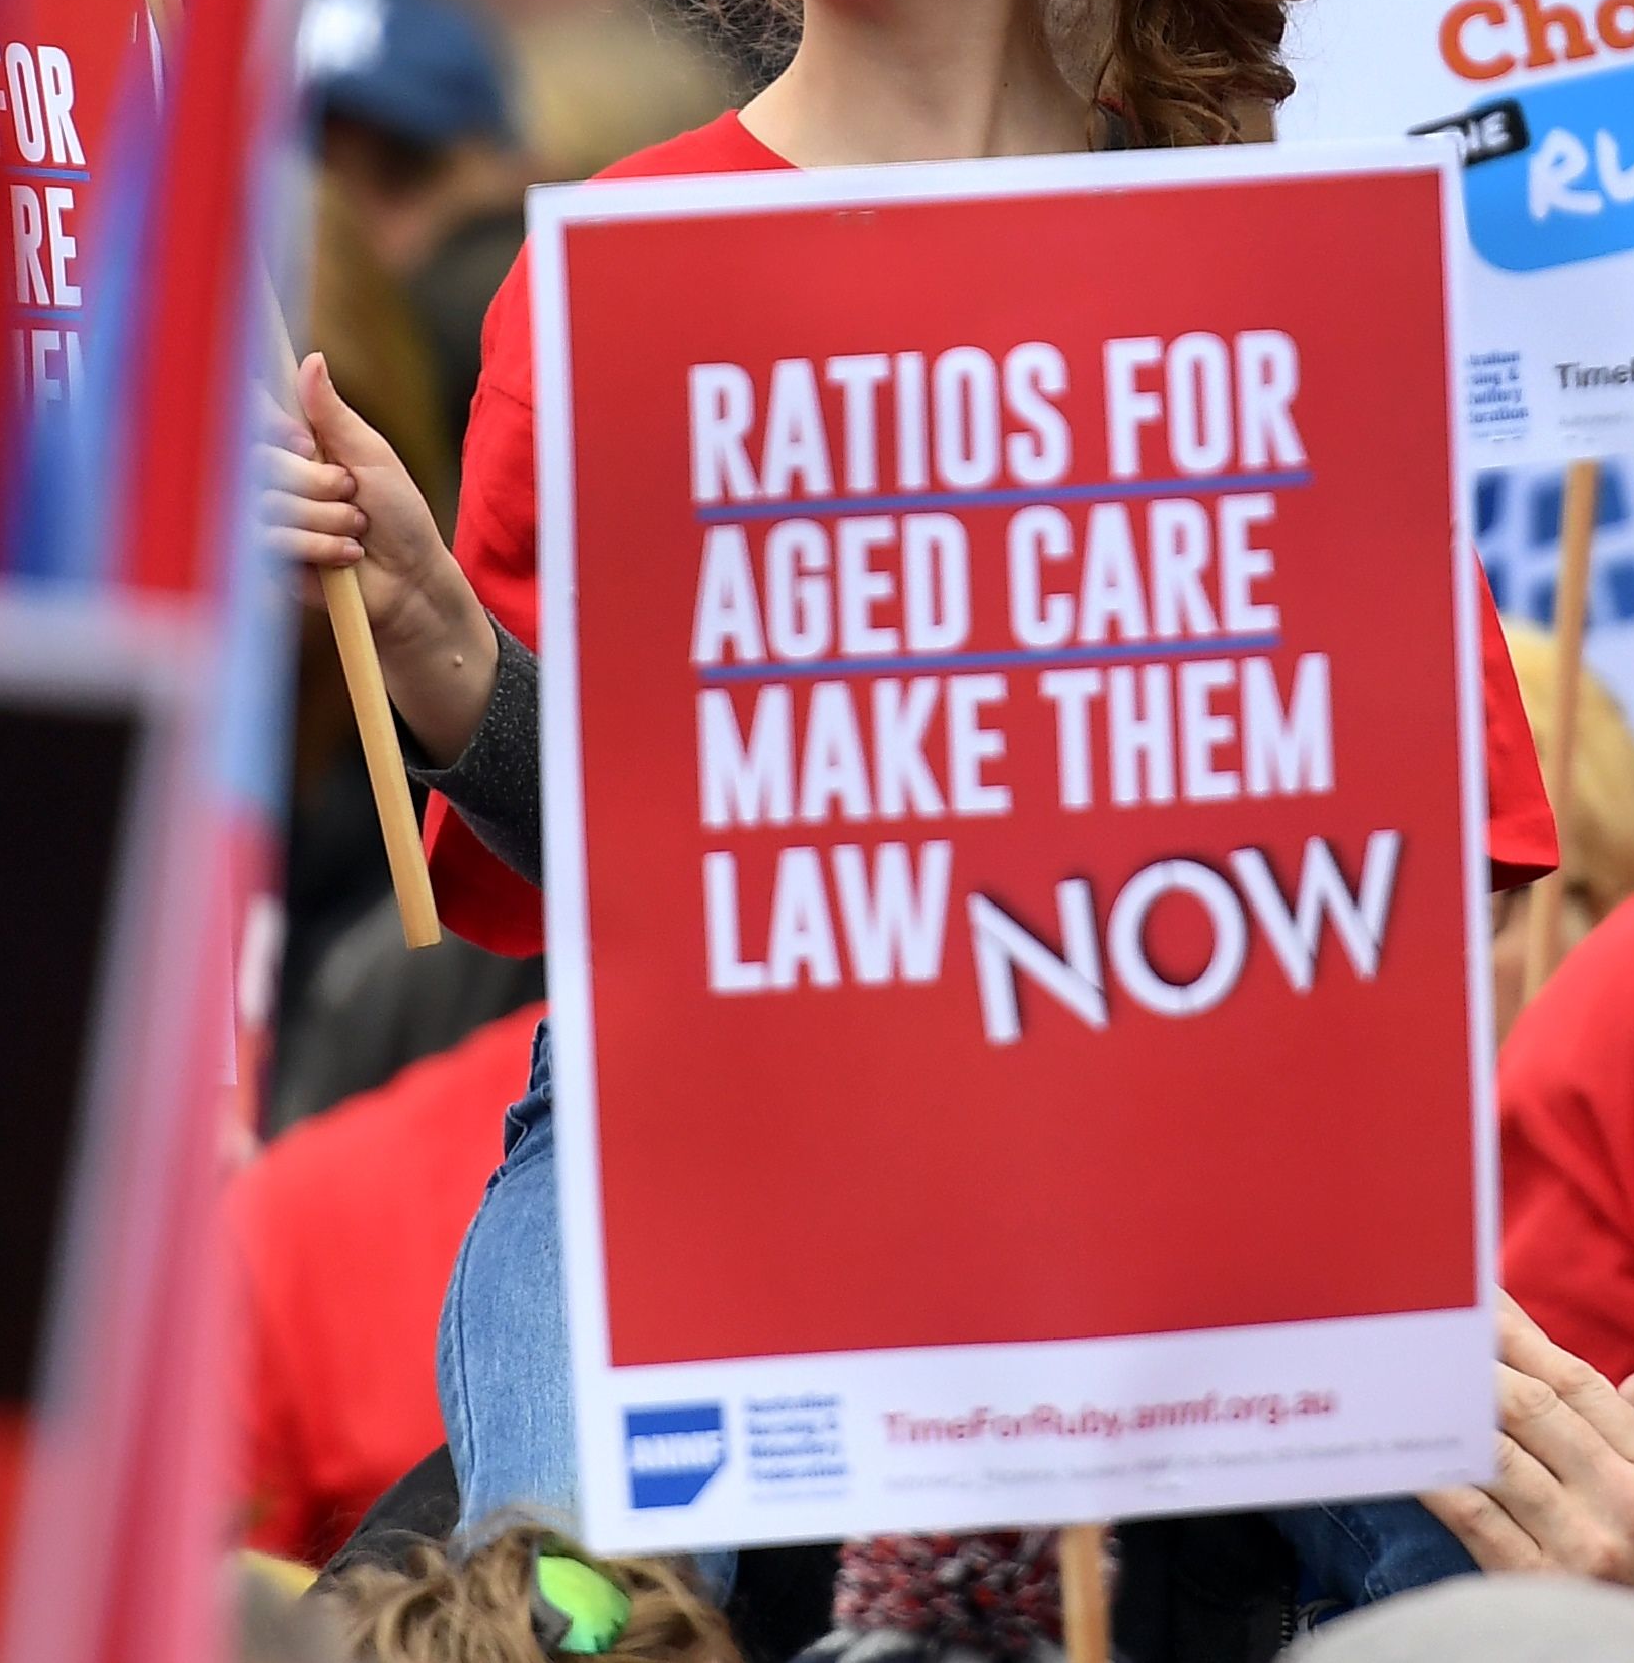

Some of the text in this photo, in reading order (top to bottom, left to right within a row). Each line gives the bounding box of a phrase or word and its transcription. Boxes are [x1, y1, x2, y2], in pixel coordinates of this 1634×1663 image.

[9, 184, 83, 307] RE
[687, 329, 1306, 507] RATIOS FOR
[690, 493, 1279, 665] AGED CARE
[698, 651, 1333, 829] MAKE THEM
[703, 828, 1404, 1046] LAW NOW
